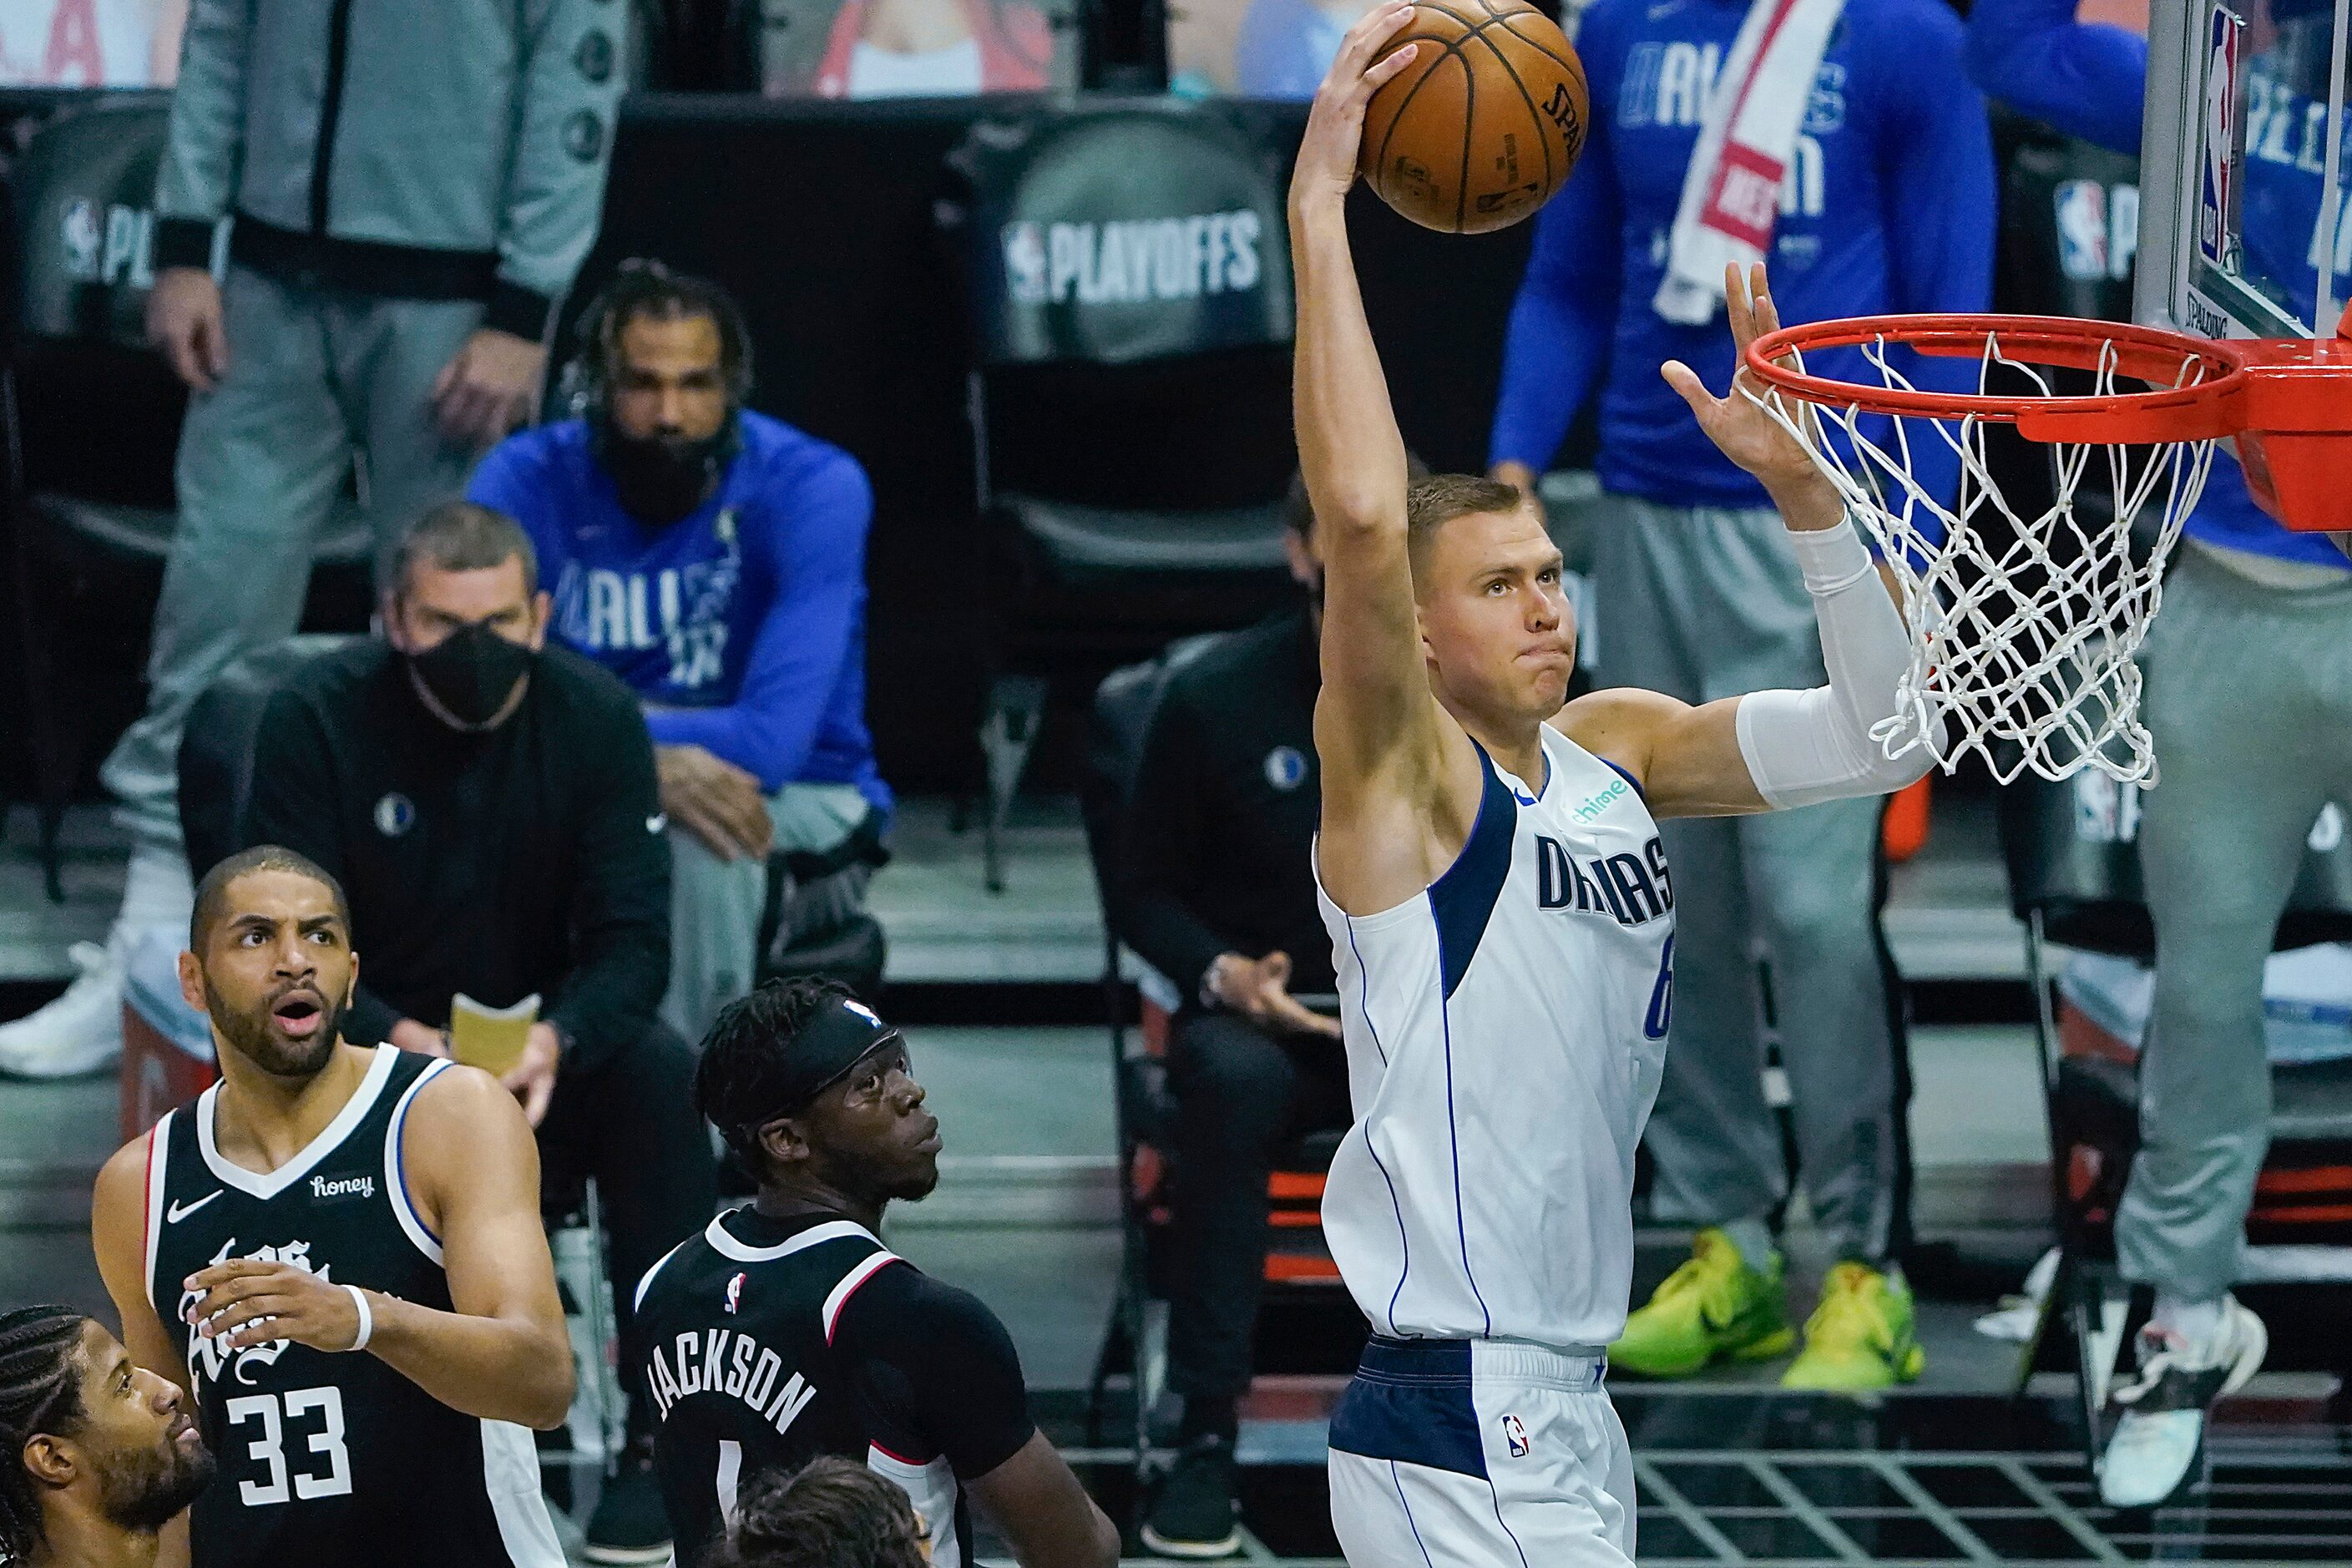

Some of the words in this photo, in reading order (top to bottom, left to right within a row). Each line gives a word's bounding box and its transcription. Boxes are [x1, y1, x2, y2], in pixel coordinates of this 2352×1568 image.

[1049, 210, 1262, 303] PLAYOFFS
[1571, 778, 1628, 825] chime
[310, 1175, 375, 1198] honey
[647, 1328, 817, 1435] JACKSON
[225, 1386, 353, 1506] 33
